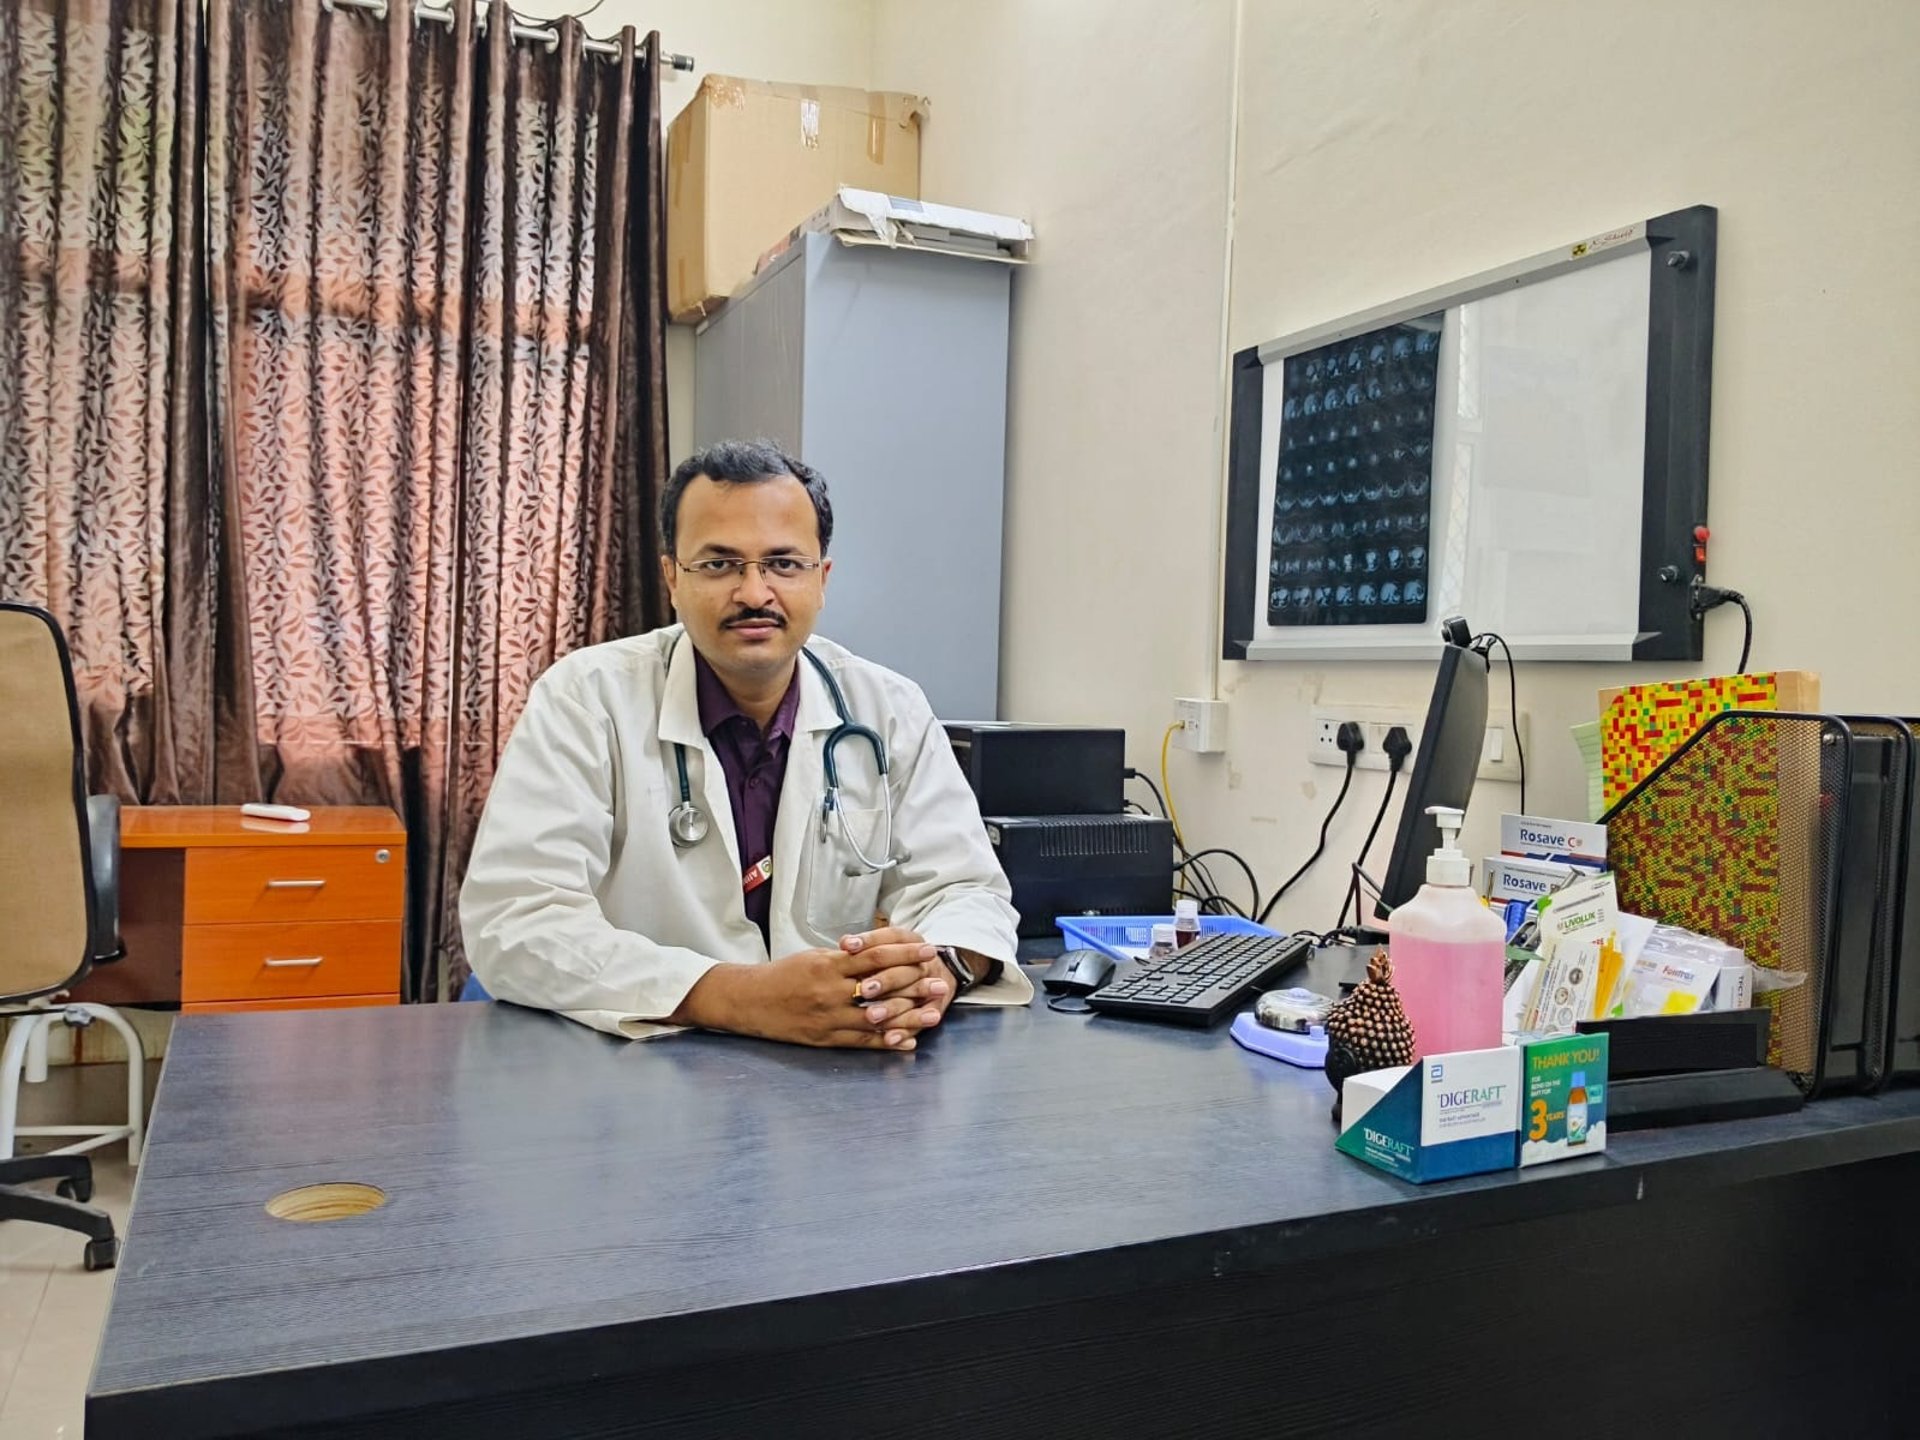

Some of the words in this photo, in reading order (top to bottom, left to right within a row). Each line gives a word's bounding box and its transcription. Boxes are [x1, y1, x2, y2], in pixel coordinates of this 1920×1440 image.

[1520, 828, 1565, 846] Rosave
[1503, 874, 1546, 892] Rosave
[1533, 1054, 1569, 1069] THANK
[1572, 1047, 1600, 1065] YOU!
[1438, 1086, 1503, 1108] DIGERAFT
[1529, 1098, 1548, 1141] 3
[1364, 1127, 1413, 1156] DIGERAFT
